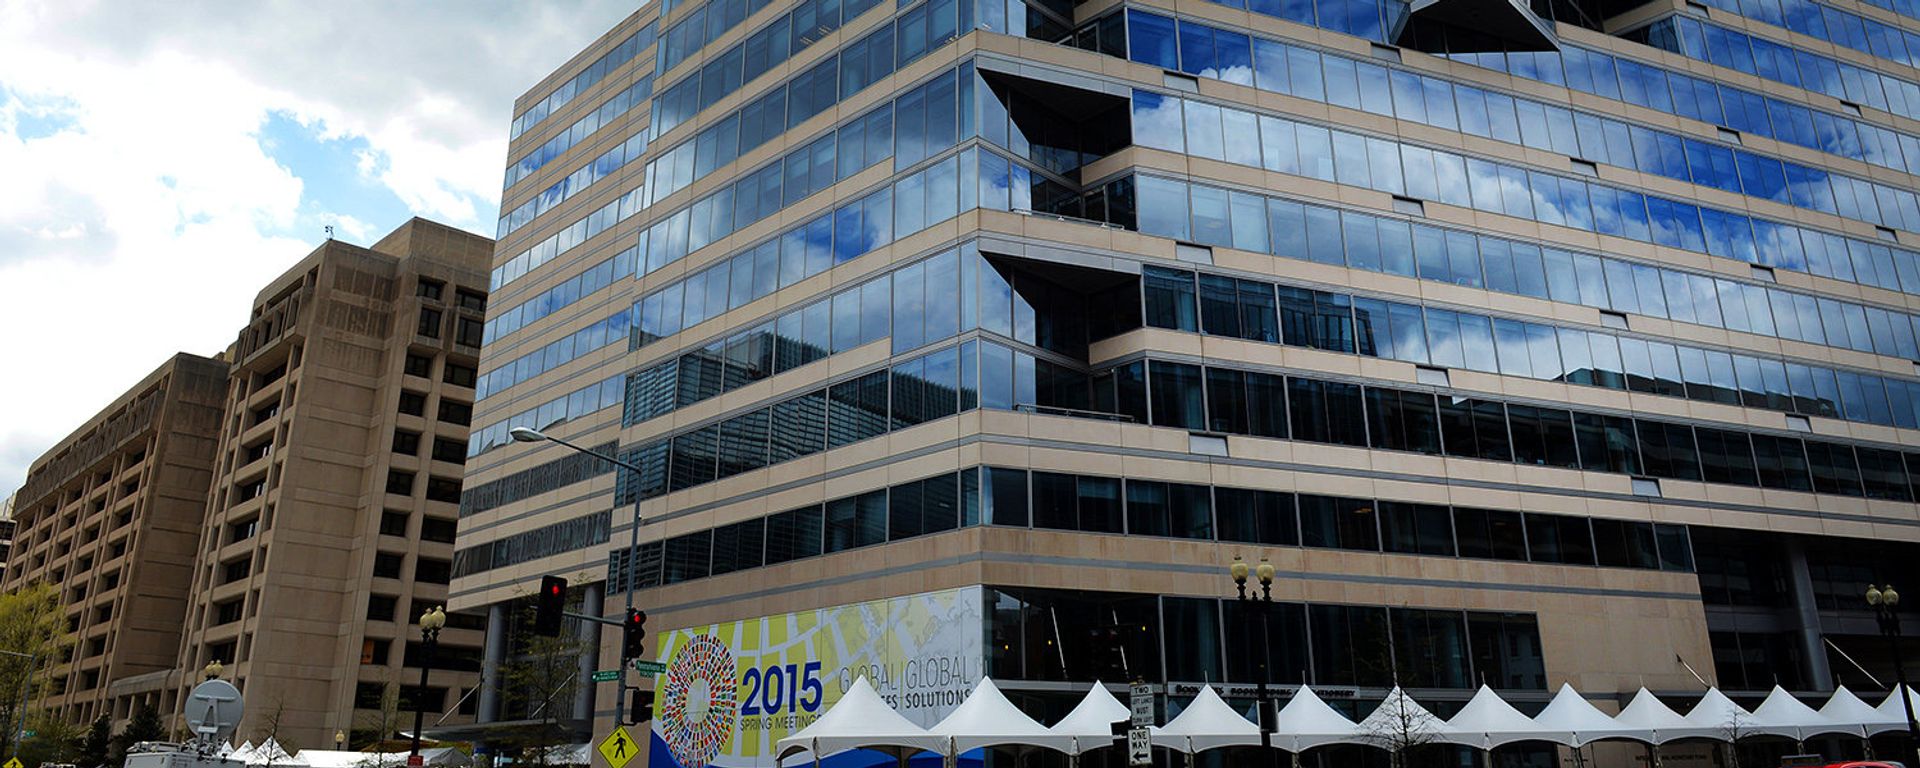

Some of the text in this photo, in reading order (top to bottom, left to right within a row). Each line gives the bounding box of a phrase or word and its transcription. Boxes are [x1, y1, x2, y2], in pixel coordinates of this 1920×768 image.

[905, 656, 971, 689] GLOBAL
[741, 661, 823, 716] 2015
[1134, 686, 1149, 694] TWO
[741, 717, 773, 731] SPRING
[1132, 731, 1147, 740] ONE
[1132, 740, 1148, 750] WAY
